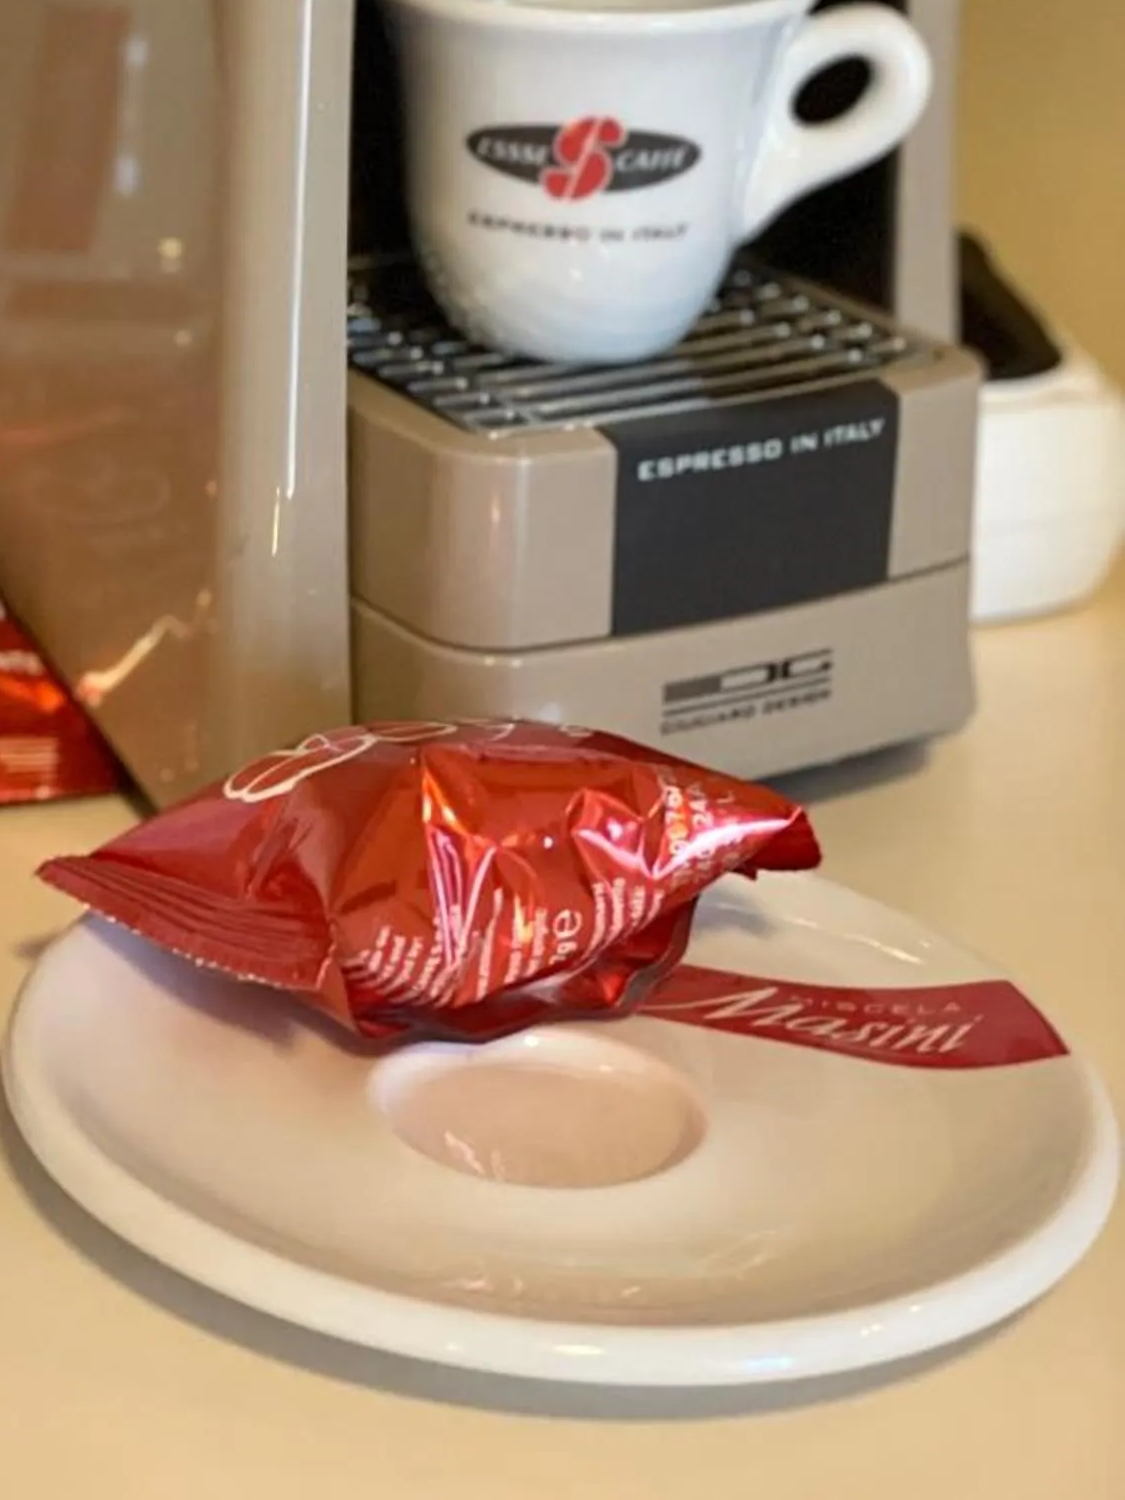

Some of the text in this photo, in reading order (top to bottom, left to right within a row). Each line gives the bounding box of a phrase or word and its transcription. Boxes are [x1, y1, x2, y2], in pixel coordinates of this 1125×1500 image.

[636, 417, 886, 482] ESPRESSO IN ITALY
[640, 986, 983, 1054] Masini
